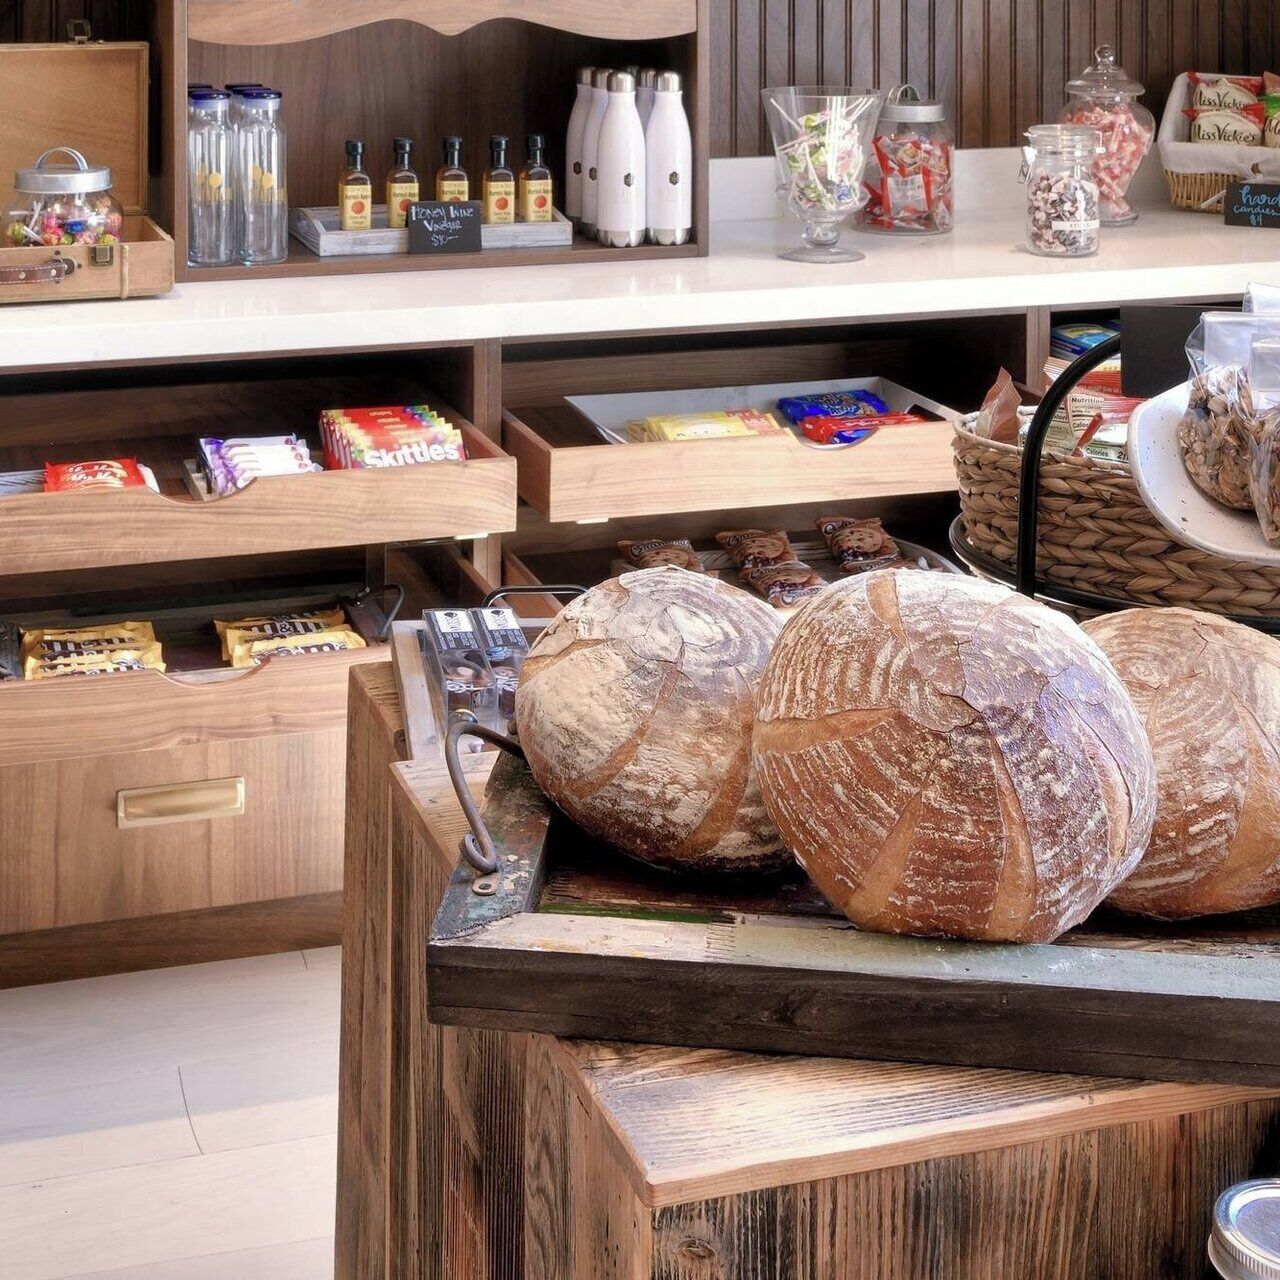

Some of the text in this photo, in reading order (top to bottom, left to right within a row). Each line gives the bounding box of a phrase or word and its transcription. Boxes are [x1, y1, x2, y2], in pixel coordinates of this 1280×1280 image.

[1214, 123, 1256, 144] Vickie's
[363, 441, 461, 469] Skittles
[1086, 447, 1109, 458] Calories
